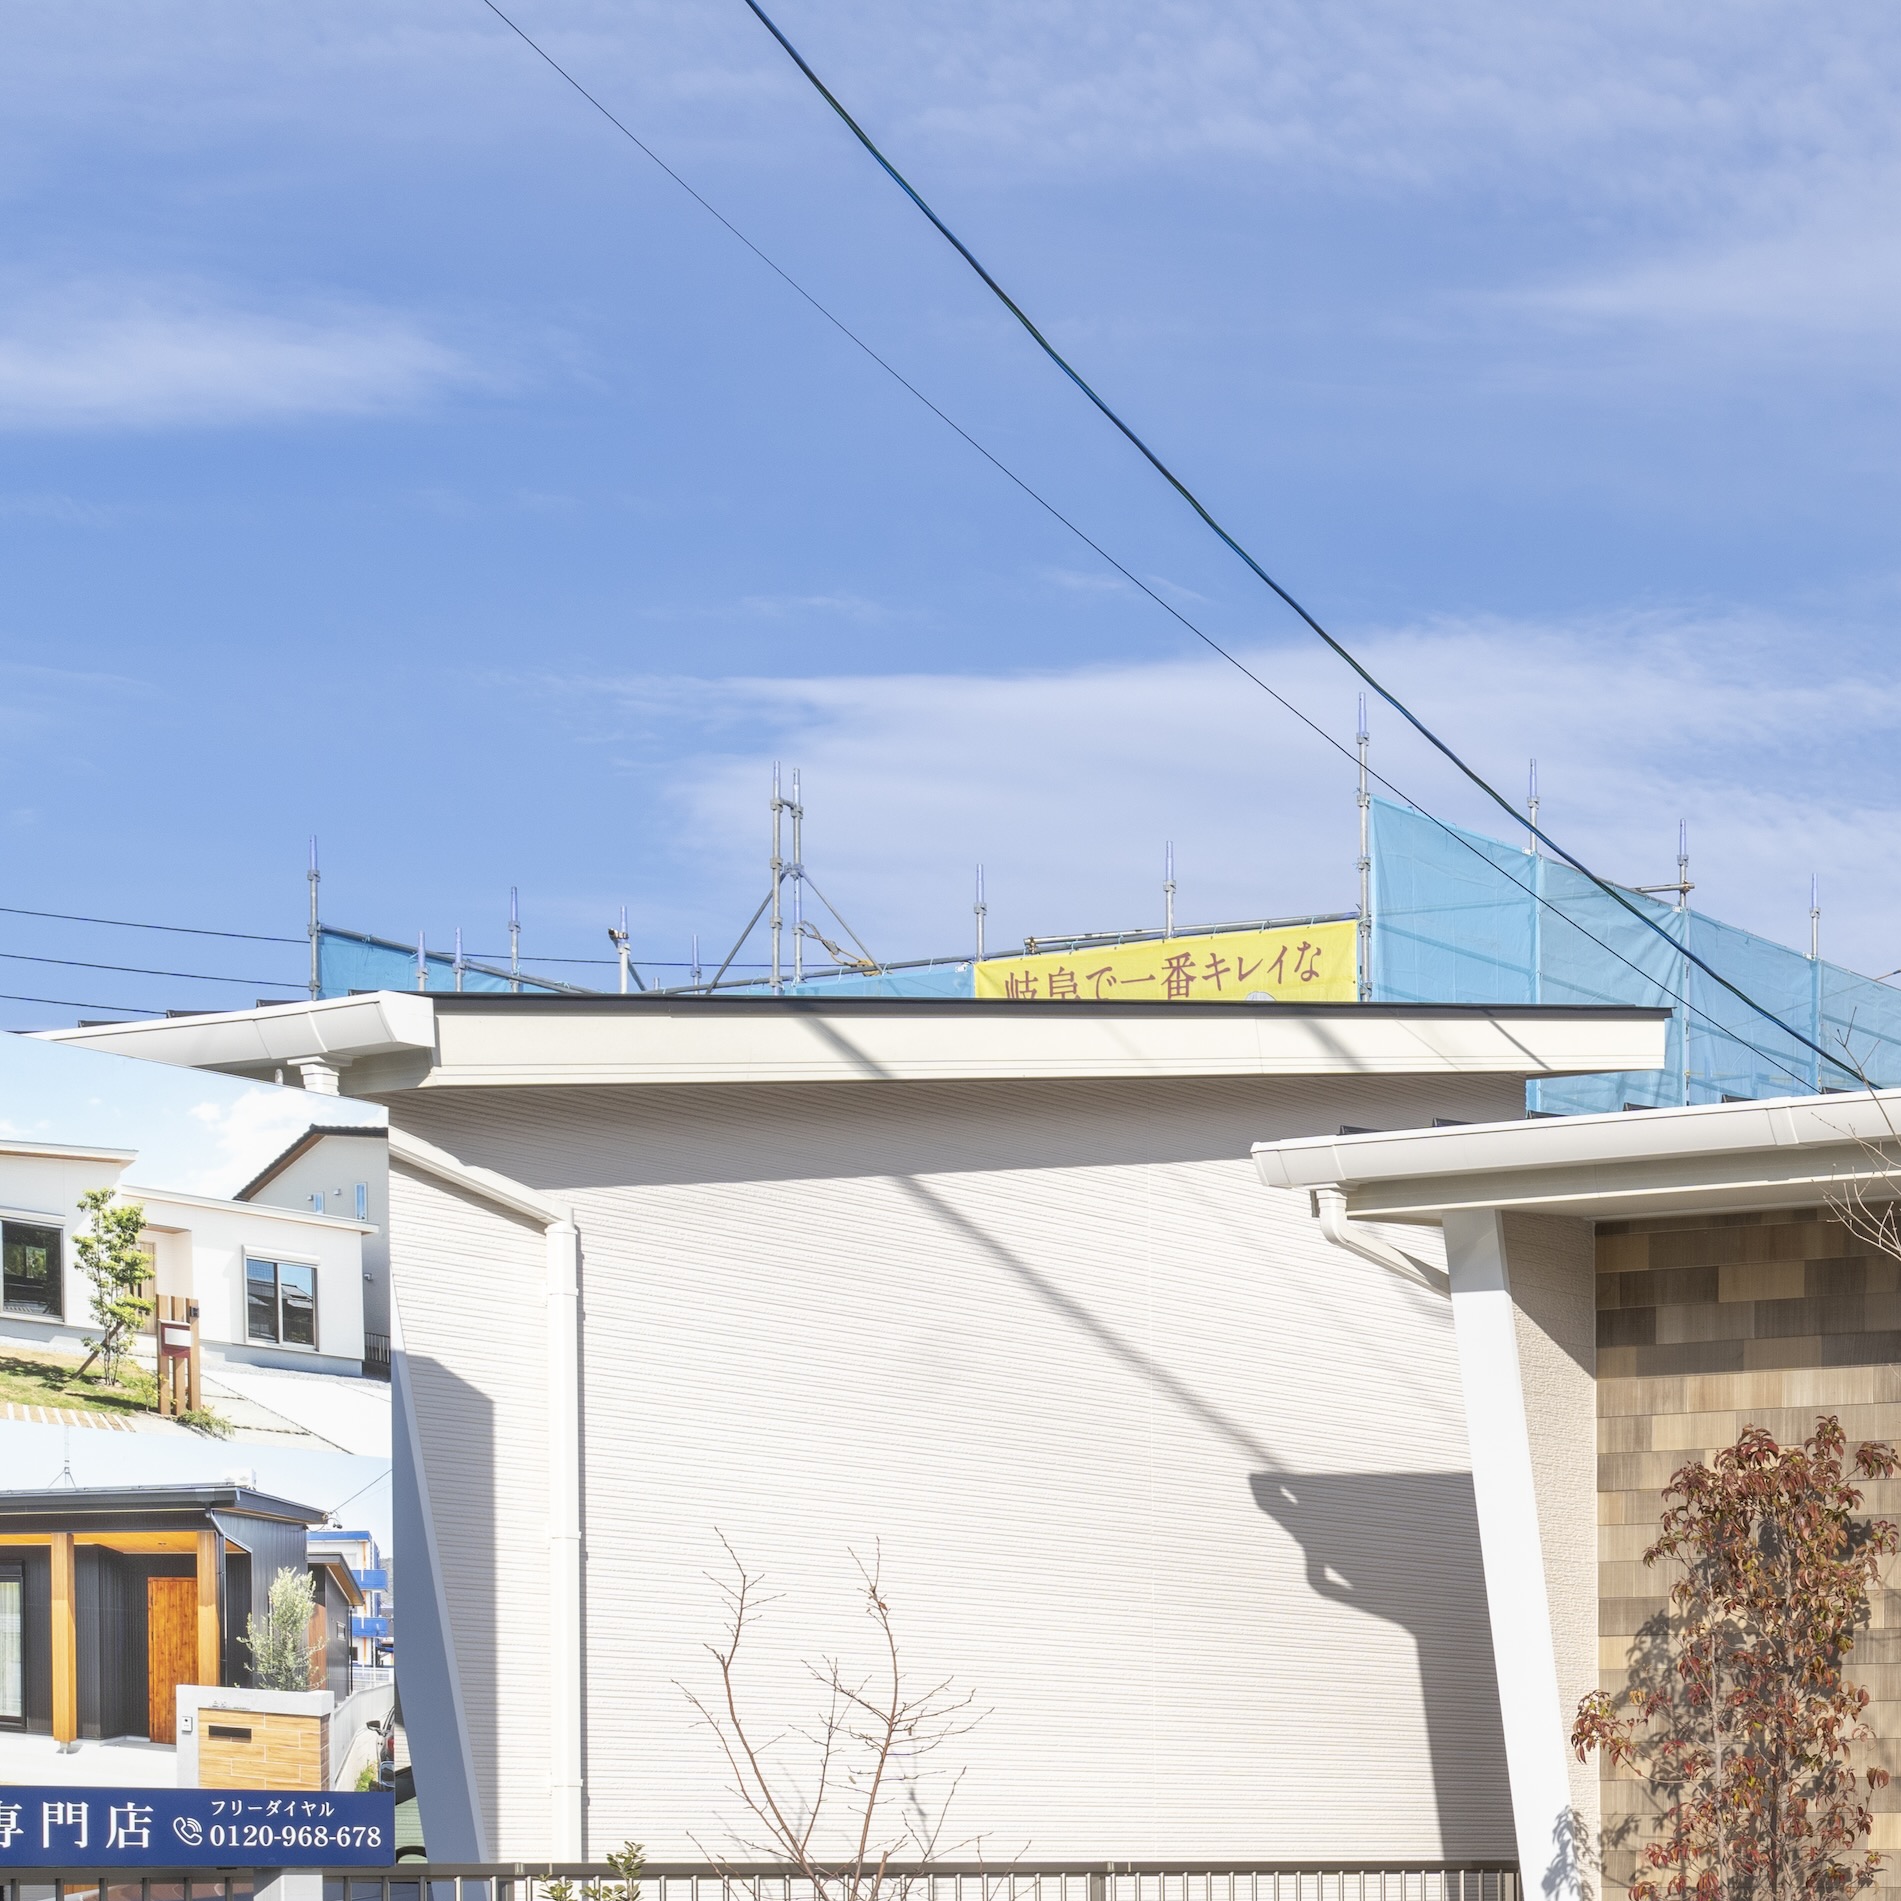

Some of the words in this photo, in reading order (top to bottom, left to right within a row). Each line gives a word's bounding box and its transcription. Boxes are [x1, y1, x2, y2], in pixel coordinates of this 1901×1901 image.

[211, 1800, 335, 1817] フリーダイヤル
[209, 1825, 382, 1848] 0120-968-678
